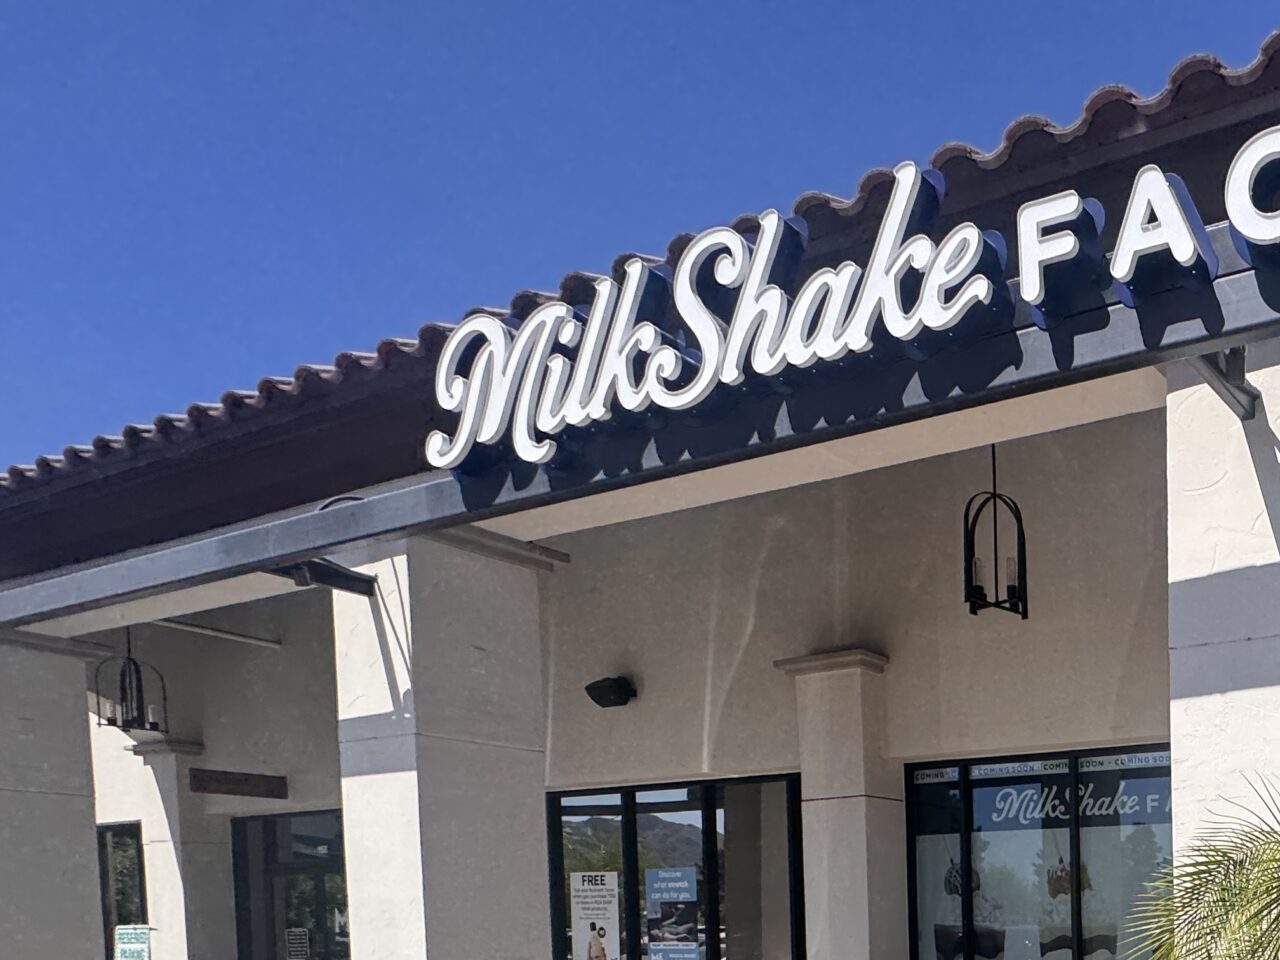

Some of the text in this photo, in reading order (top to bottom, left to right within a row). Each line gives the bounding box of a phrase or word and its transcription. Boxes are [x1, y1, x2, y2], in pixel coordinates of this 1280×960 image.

[425, 161, 992, 469] MilkShake
[978, 762, 1069, 776] COMING SOON COMIN
[1080, 759, 1104, 769] SOON
[1114, 756, 1150, 766] COMING
[915, 771, 945, 781] COMING
[581, 874, 606, 886] FREE
